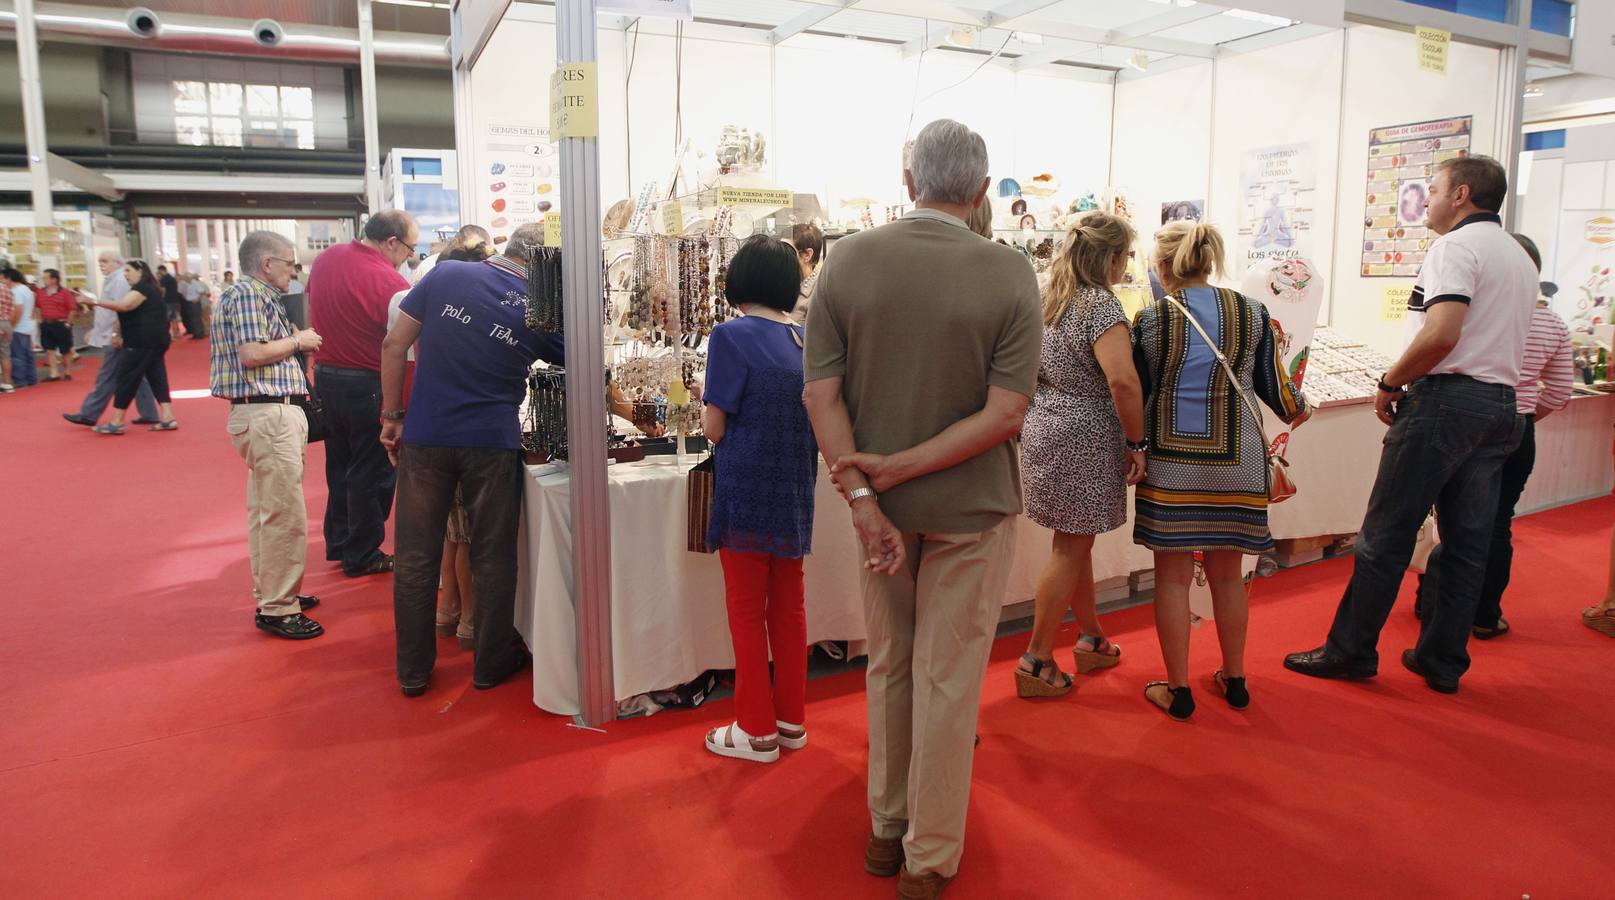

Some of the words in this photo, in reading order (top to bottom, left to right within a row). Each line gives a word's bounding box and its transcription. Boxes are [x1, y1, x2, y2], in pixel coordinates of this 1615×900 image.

[520, 128, 535, 136] DEL
[441, 303, 471, 324] POLO
[489, 323, 519, 347] TEAM
